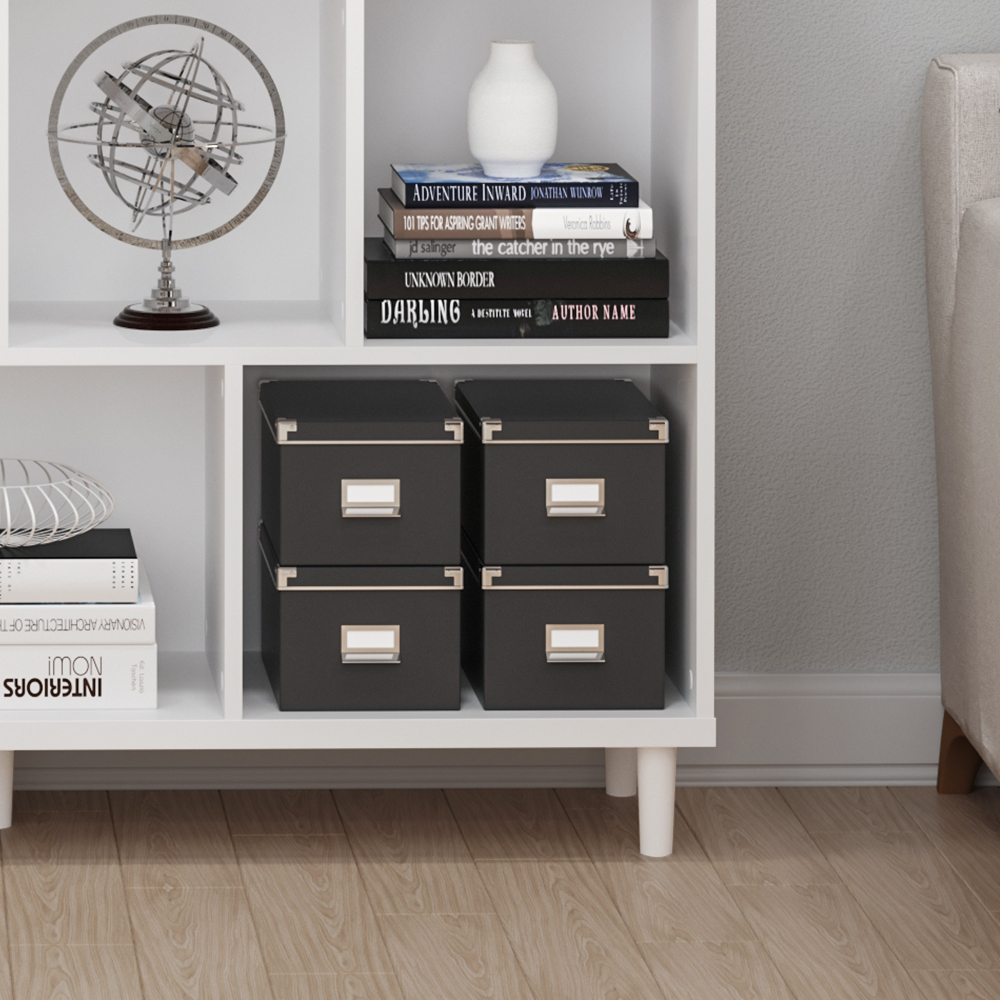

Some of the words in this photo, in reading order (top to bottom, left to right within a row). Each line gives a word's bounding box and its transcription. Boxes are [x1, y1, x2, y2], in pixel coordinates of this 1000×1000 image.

[530, 186, 568, 200] JONATHAN
[403, 215, 415, 230] 101
[417, 215, 429, 230] TIPS
[430, 215, 444, 230] FOR
[475, 215, 498, 230] GRANT
[500, 215, 526, 230] WRITERS
[409, 241, 418, 257] jd
[421, 241, 456, 257] salinger
[471, 239, 493, 255] the
[498, 239, 548, 255] catcher
[550, 239, 563, 255] in
[567, 239, 590, 255] the
[593, 242, 615, 258] rye
[405, 271, 455, 288] UNKNOWN
[456, 271, 495, 288] BORDER
[381, 299, 461, 329] DARLING
[552, 304, 599, 320] AUTHOR
[603, 304, 636, 320] NAME
[9, 618, 23, 632] OF
[25, 618, 97, 632] ARCHITECTURE
[98, 618, 145, 632] VISIONARY
[48, 656, 102, 676] NOW!
[3, 678, 102, 697] INTERIORS
